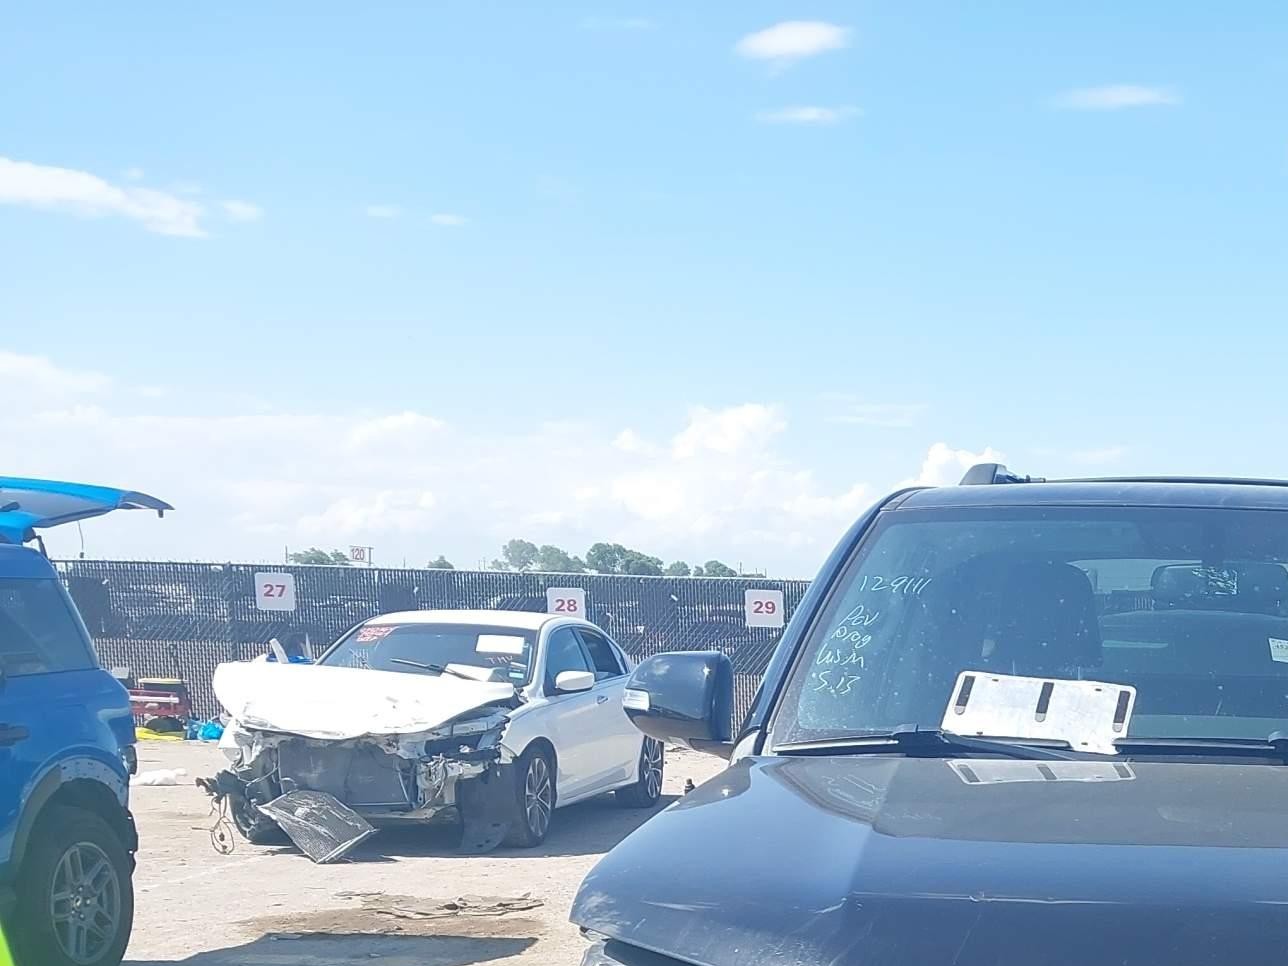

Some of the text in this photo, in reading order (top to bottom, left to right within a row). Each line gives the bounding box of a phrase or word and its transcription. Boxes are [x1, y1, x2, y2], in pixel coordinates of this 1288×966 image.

[350, 547, 366, 561] 120
[262, 583, 286, 598] 27
[554, 598, 578, 612] 28
[753, 600, 777, 615] 29
